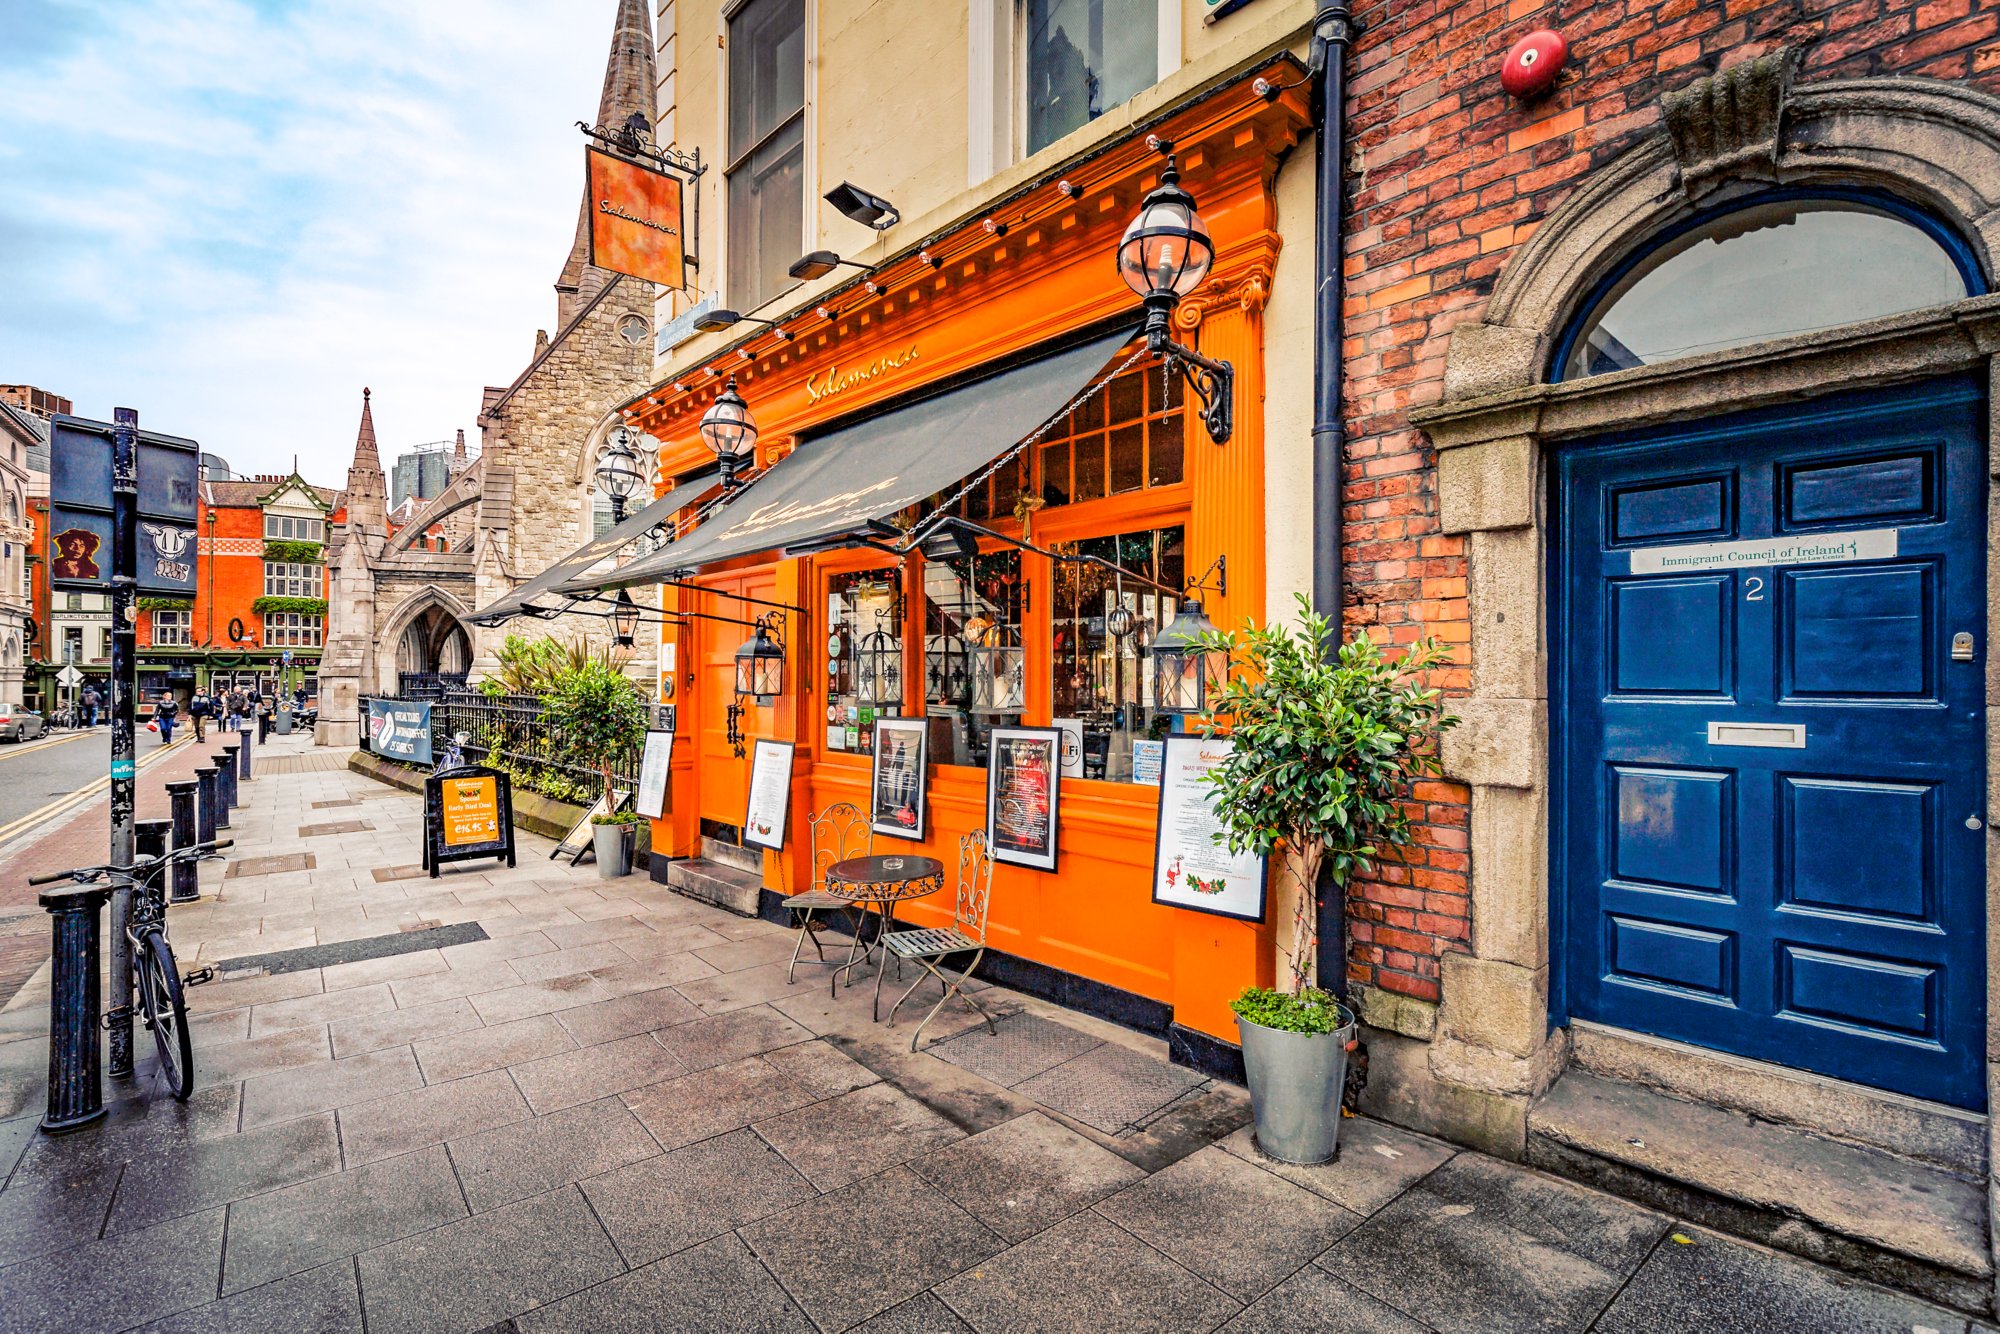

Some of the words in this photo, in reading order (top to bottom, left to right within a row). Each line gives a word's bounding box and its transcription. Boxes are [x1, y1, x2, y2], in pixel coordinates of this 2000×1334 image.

[600, 199, 677, 235] Salamanca
[806, 344, 920, 405] Salamanca
[1661, 553, 1725, 568] Immigrant
[1727, 548, 1776, 562] Council
[1780, 547, 1795, 559] of
[1796, 543, 1845, 556] Ireland
[1767, 556, 1807, 564] Independent
[1822, 552, 1846, 561] Centre
[1745, 577, 1765, 601] 2
[448, 804, 464, 812] Early
[459, 795, 480, 803] Special
